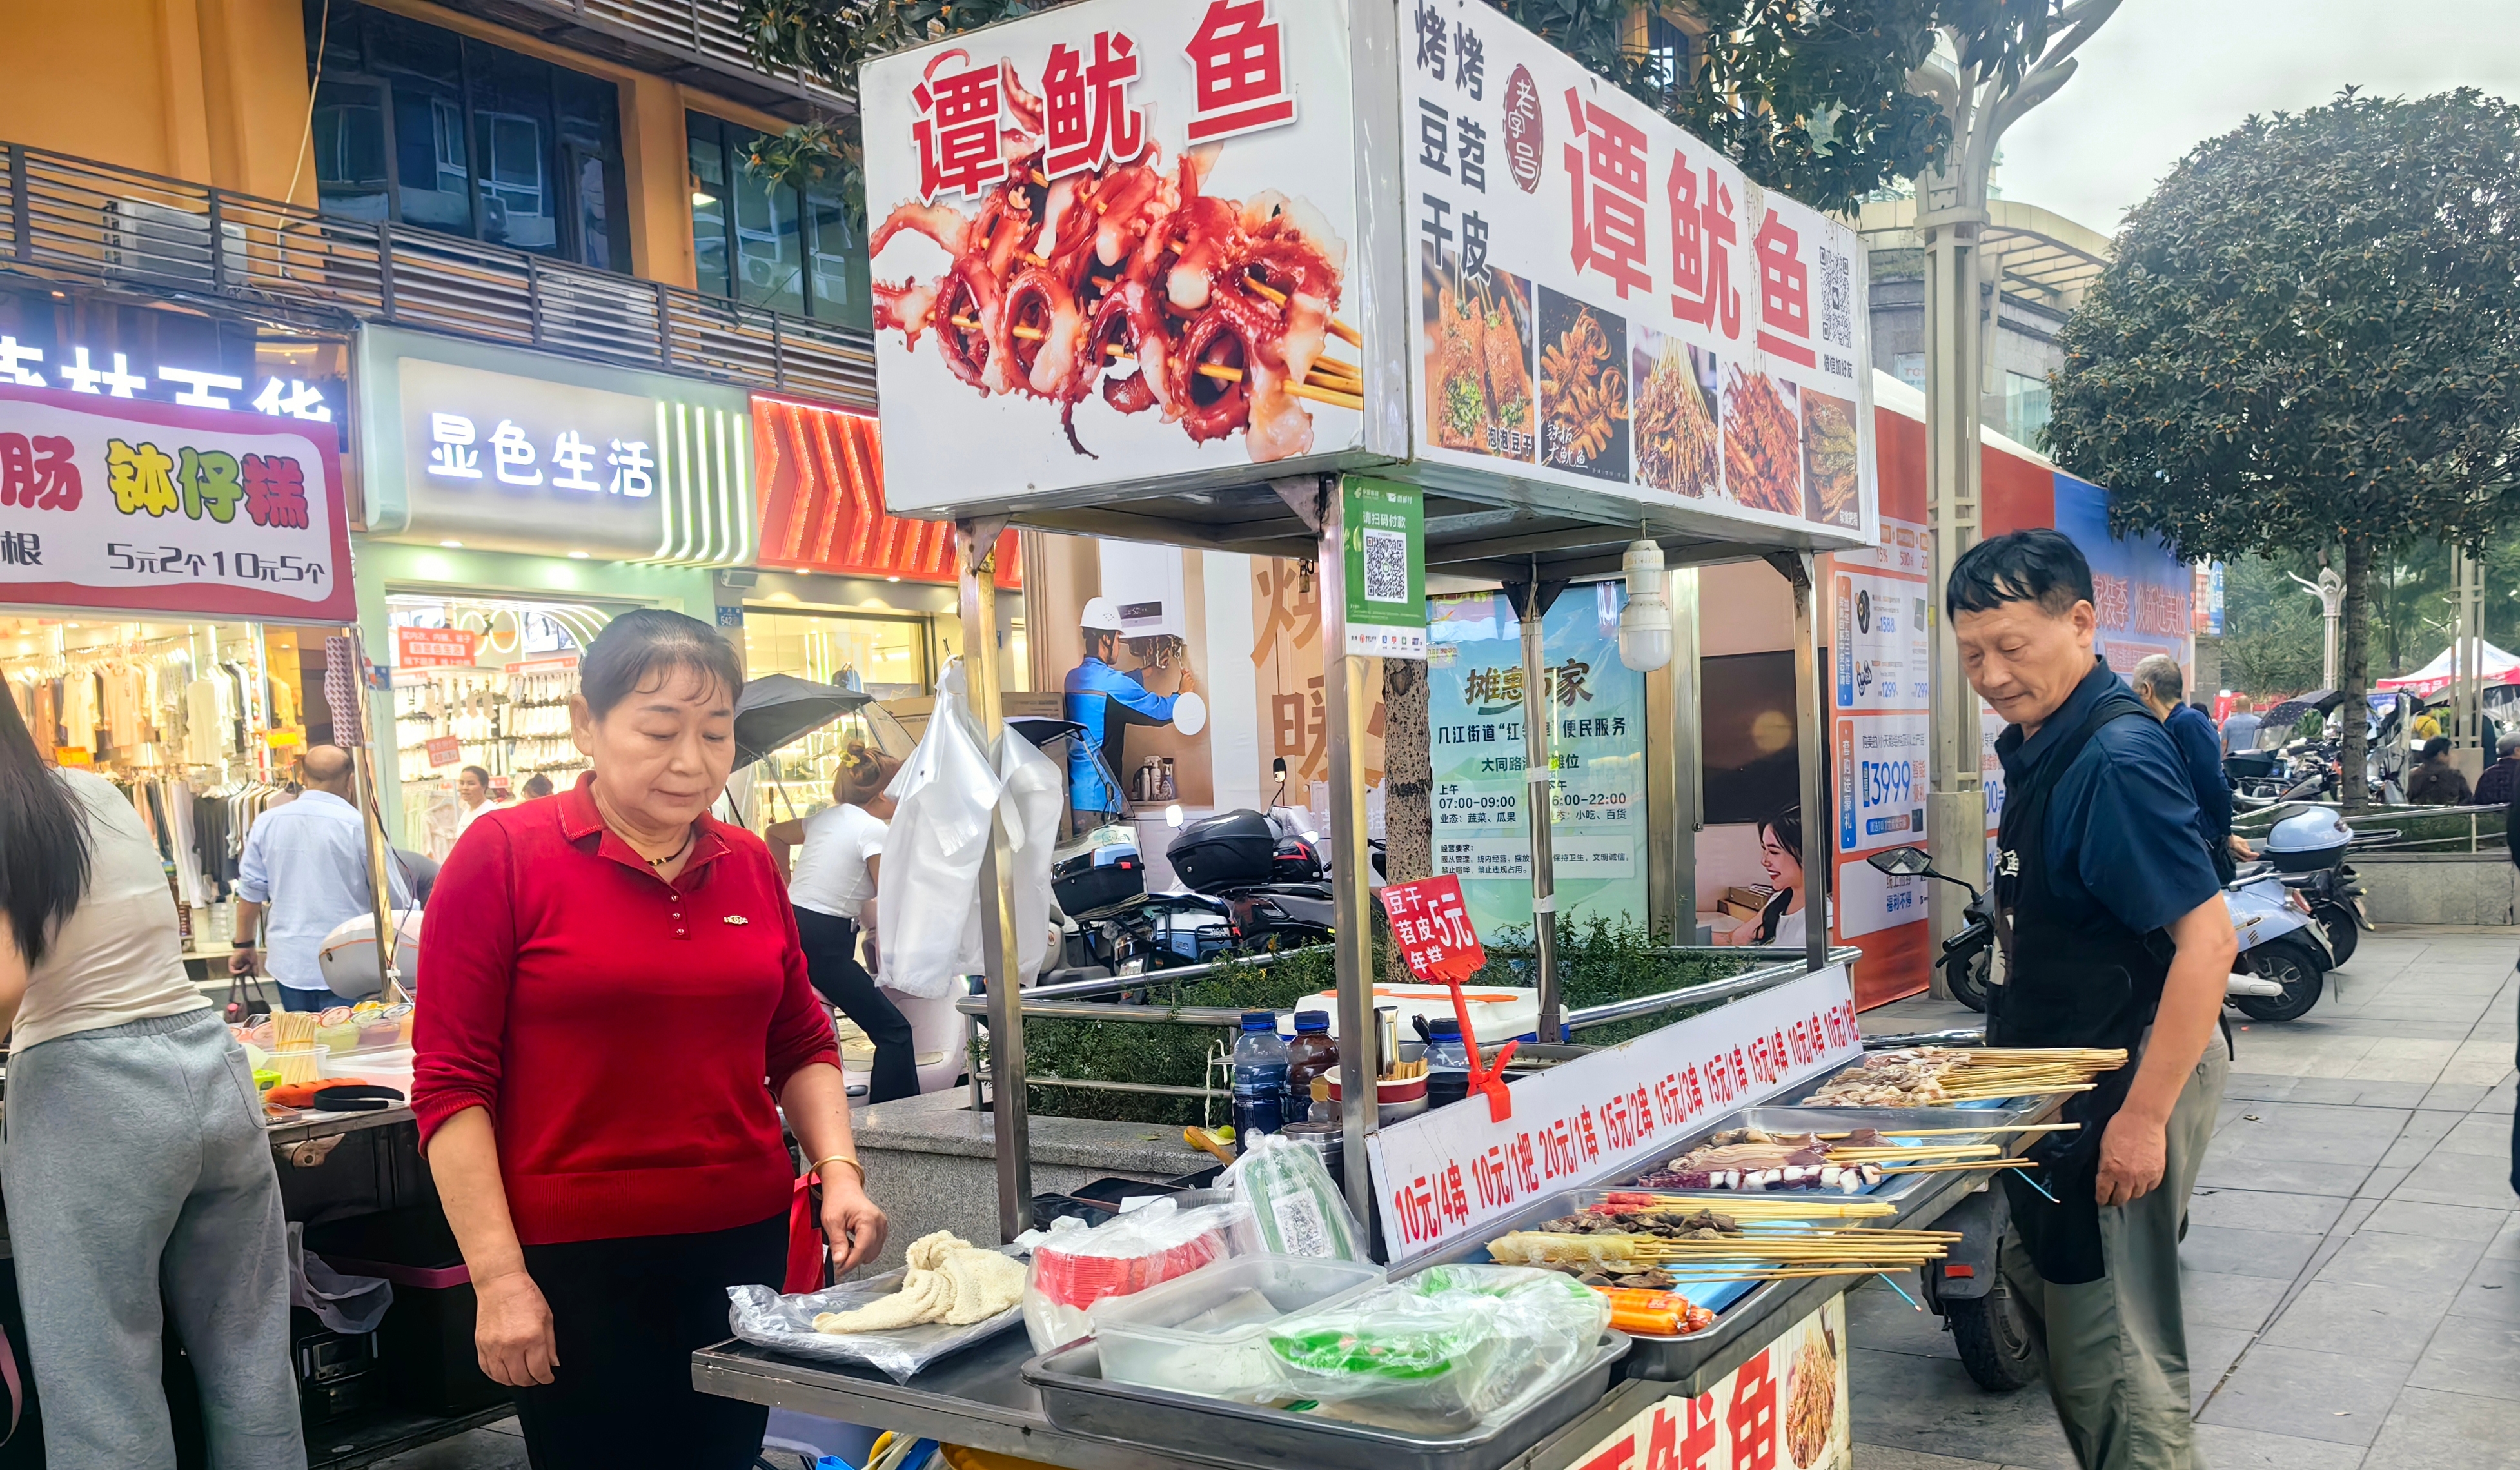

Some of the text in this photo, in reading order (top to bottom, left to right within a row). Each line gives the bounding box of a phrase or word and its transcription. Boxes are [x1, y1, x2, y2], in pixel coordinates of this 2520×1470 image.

[912, 0, 1294, 202] 谭鱿鱼
[1414, 5, 1453, 271] 烤豆干
[1508, 79, 1538, 179] 老字号
[1453, 21, 1491, 287] 烤苕皮
[1564, 87, 1816, 369] 谭鱿鱼
[1824, 354, 1853, 379] 微信加好友
[1487, 426, 1533, 457] 泡泡豆干
[1546, 420, 1575, 445] 铁板
[428, 411, 655, 498] 显色生活
[1548, 442, 1588, 469] 大鱿鱼
[104, 438, 310, 530] 钵仔糕
[1363, 511, 1406, 529] 请扫码付款
[720, 616, 733, 625] 542
[2093, 576, 2128, 628] 家装季
[1482, 754, 1580, 772] 大同路摊位
[1439, 784, 1459, 795] 上午
[1551, 792, 1626, 806] 6:00-22:00
[1871, 761, 1910, 805] 3999
[1439, 796, 1515, 810] 07:00-09:00
[1386, 887, 1474, 950] 豆干 5元
[1395, 916, 1435, 946] 苕皮
[1395, 999, 1860, 1244] 10元/4串 10元/1把 20元/1串 15元/2串 15元/3串 15元/1串 15元/4串 10元/4串 10元/1把
